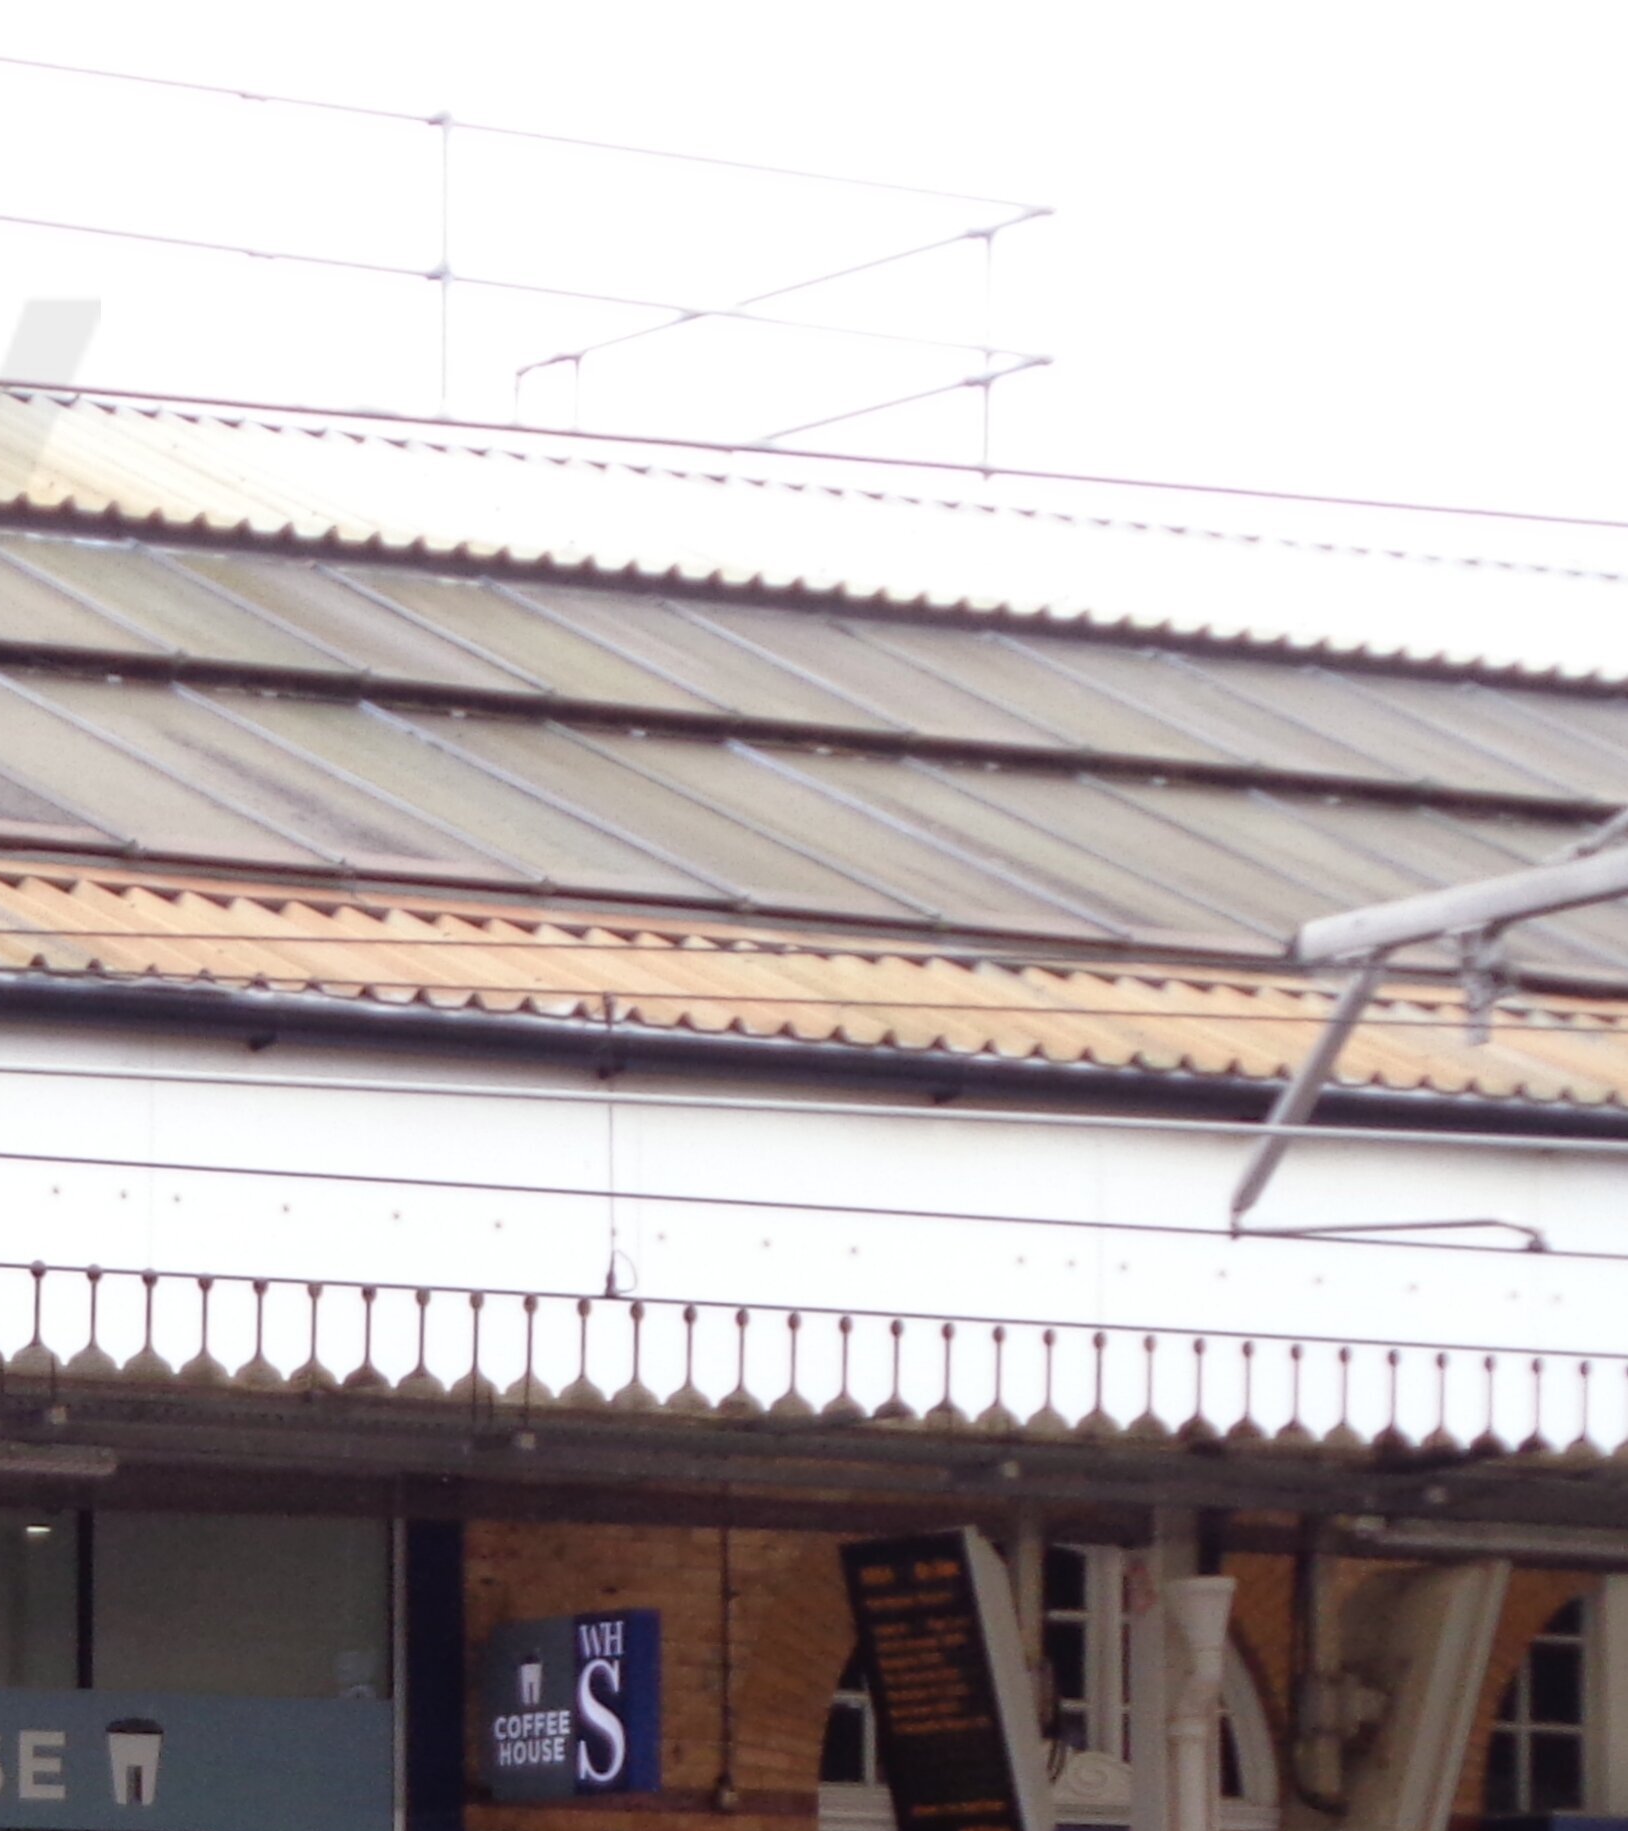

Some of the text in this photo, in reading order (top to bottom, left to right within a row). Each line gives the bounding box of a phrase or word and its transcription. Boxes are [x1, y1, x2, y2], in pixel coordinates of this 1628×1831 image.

[578, 1621, 625, 1657] WH
[494, 1710, 571, 1741] COFFEE
[577, 1658, 627, 1784] S
[499, 1742, 566, 1767] HOUSE
